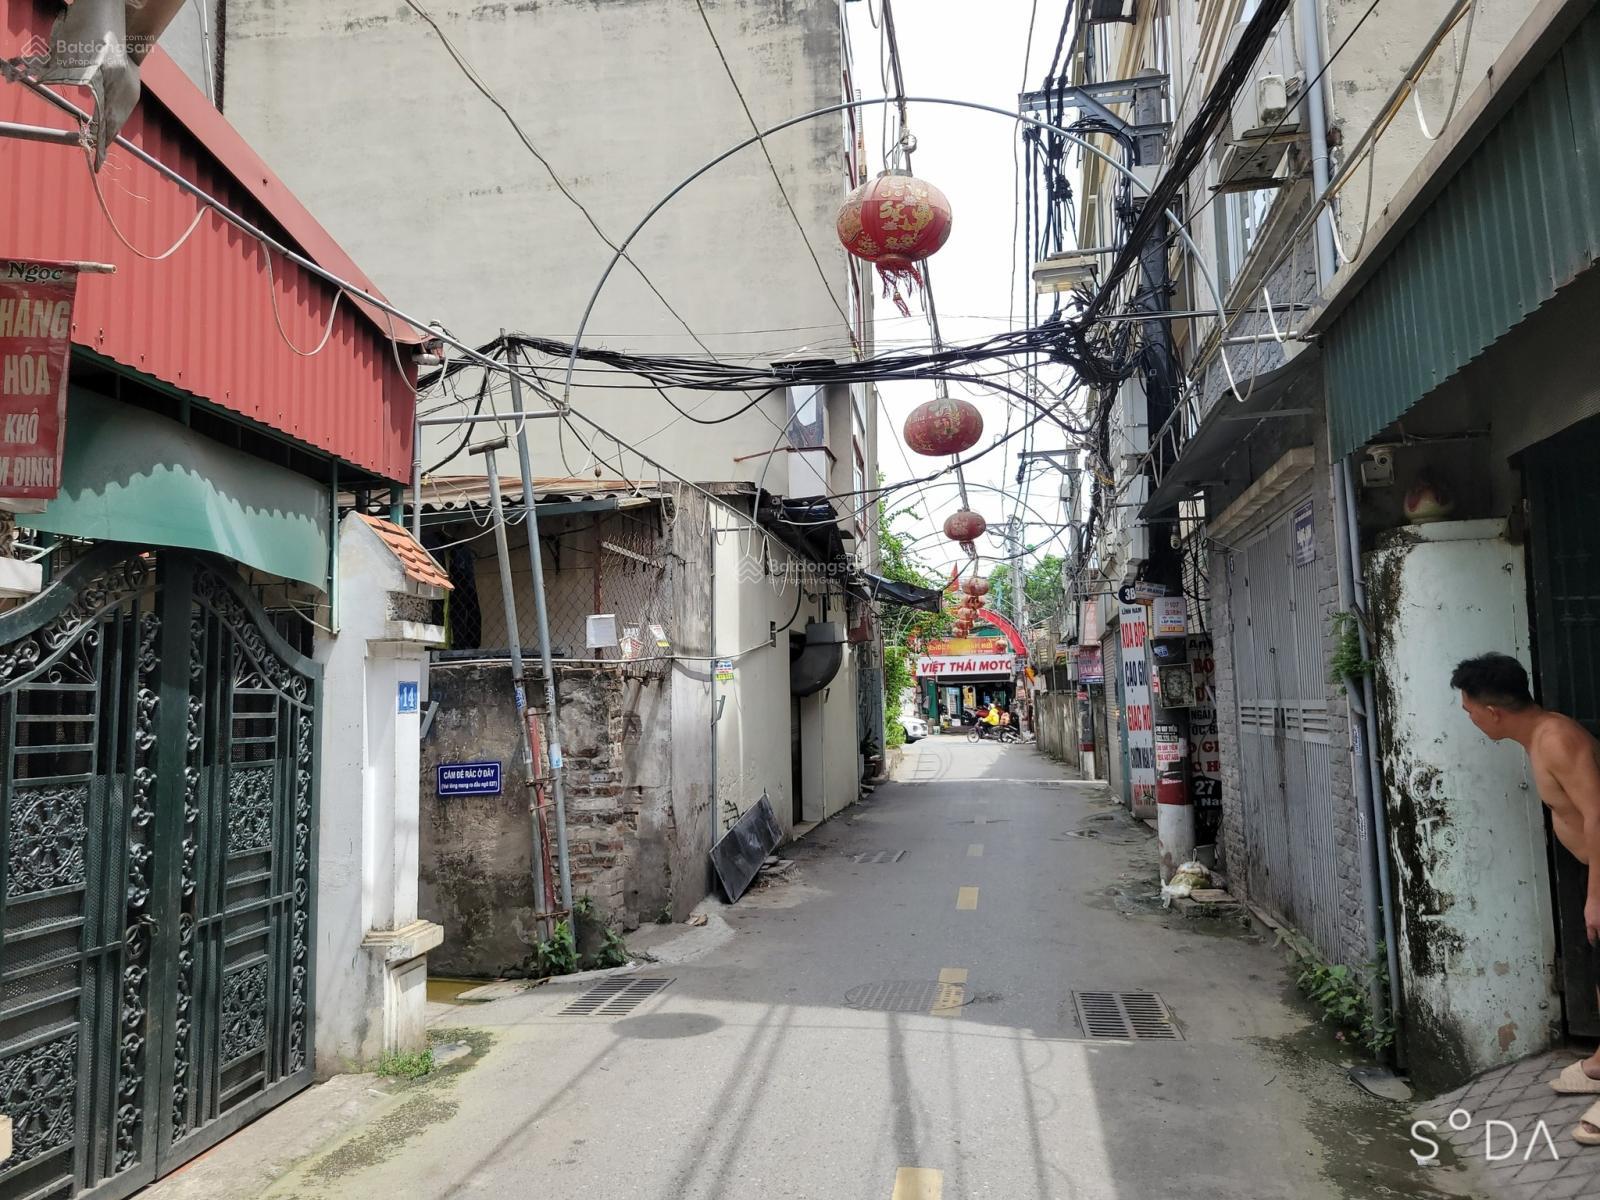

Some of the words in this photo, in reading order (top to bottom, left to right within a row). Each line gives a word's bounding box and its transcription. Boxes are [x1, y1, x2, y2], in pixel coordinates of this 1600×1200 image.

[7, 261, 64, 284] Ngọc
[0, 290, 71, 339] HÀNG
[3, 346, 51, 395] HÓA
[4, 407, 40, 445] KHÔ
[14, 457, 54, 493] ĐỊNH
[921, 660, 946, 673] VIỆT
[949, 659, 976, 671] THÁI
[403, 687, 415, 707] 14
